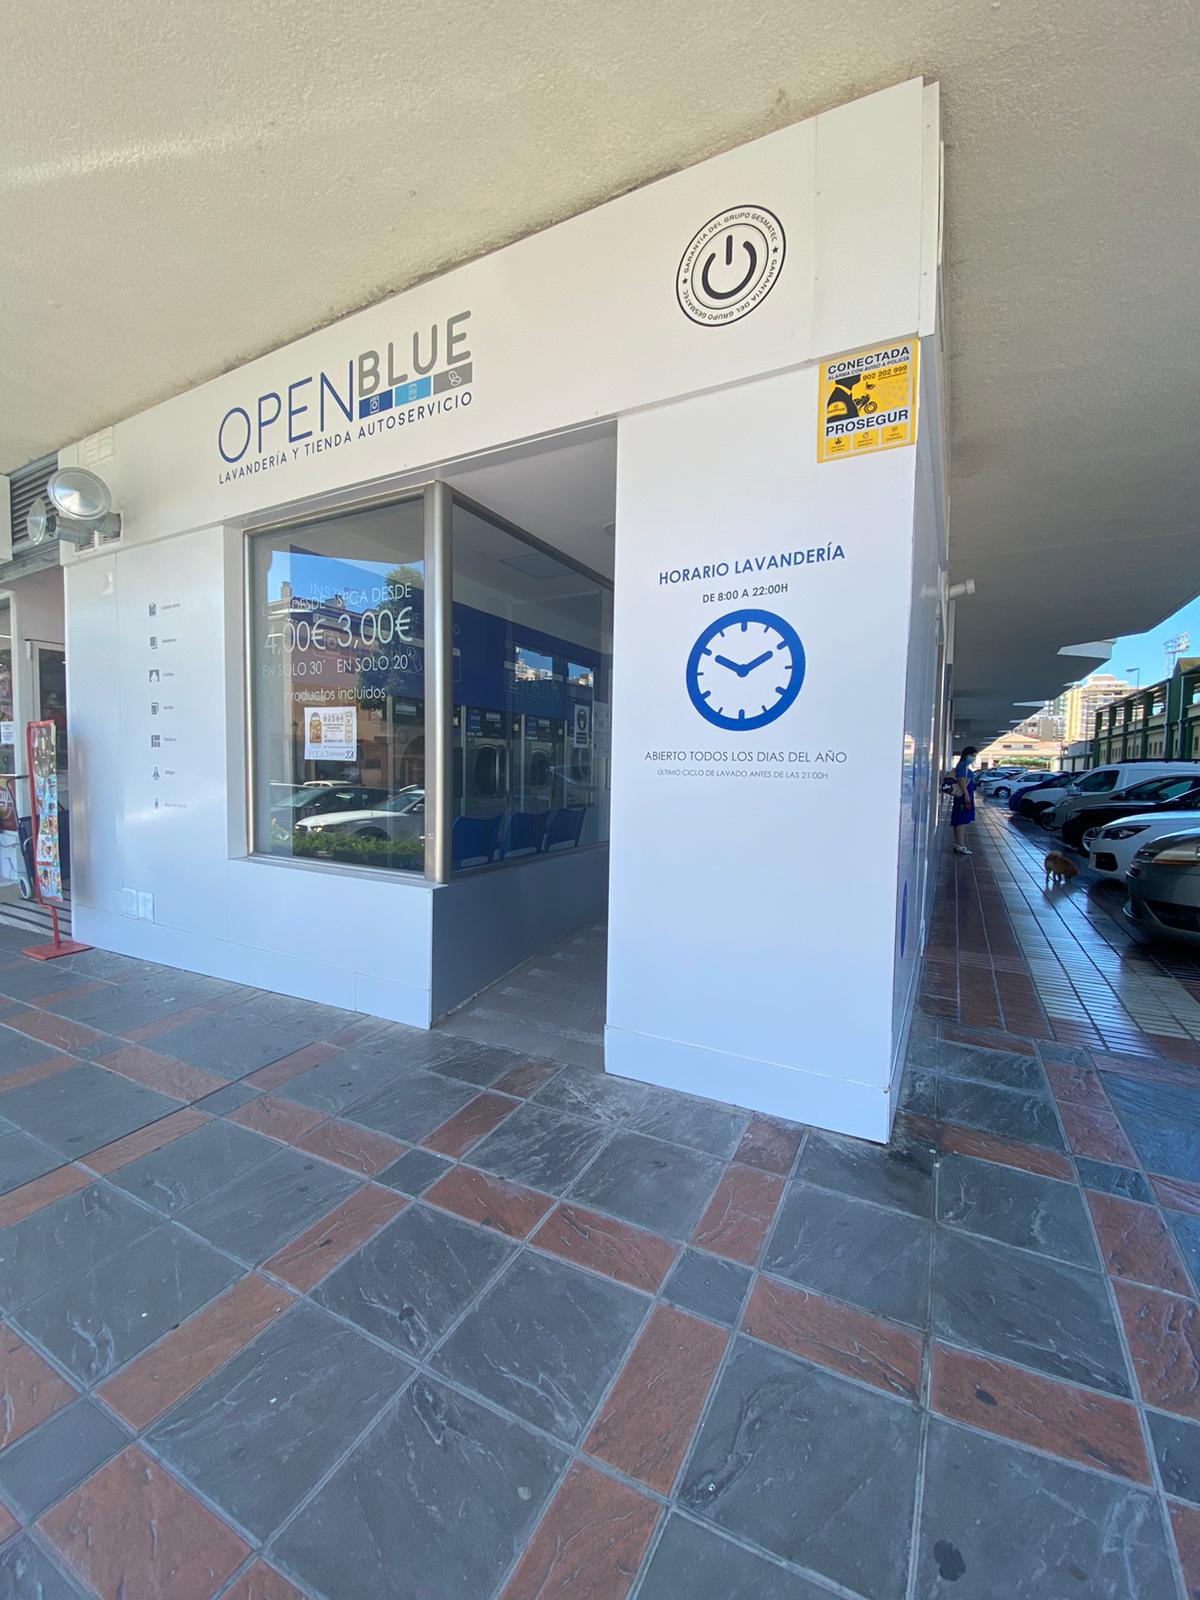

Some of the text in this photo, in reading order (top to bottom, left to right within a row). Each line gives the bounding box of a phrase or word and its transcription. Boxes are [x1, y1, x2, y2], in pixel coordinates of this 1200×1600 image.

[684, 212, 778, 273] GARANTIA DEL GRUPO GESMATEC
[683, 259, 777, 320] GARANTIA DEL GRUPO GESMATEC
[828, 346, 910, 375] CONECTADA
[828, 370, 851, 380] ALARMA
[851, 366, 864, 375] CON
[863, 363, 880, 373] AVISO
[862, 373, 876, 381] 902
[878, 369, 891, 377] 202
[893, 365, 907, 374] 999
[826, 409, 909, 436] PROSEGUR
[219, 391, 472, 485] LAVANDERÍA Y TIENDA AUTOSERVICIO
[659, 542, 845, 585] HORARIO LAVANDERÍA
[372, 583, 412, 601] DESDE
[702, 583, 788, 603] DE 8:00 A 22:00H
[337, 606, 413, 649] 3,00€
[278, 661, 306, 676] SOLO
[337, 659, 351, 673] EN
[355, 656, 389, 672] SOLO
[338, 686, 386, 700] incluidos
[645, 750, 847, 763] ABIERTO TODOS LOS DIAS DEL AÑO
[706, 769, 715, 777] DE
[716, 769, 748, 778] LAVADO
[749, 770, 772, 778] ANTES
[774, 770, 784, 778] DE
[786, 771, 800, 779] LAS
[801, 771, 828, 780] 21:00H
